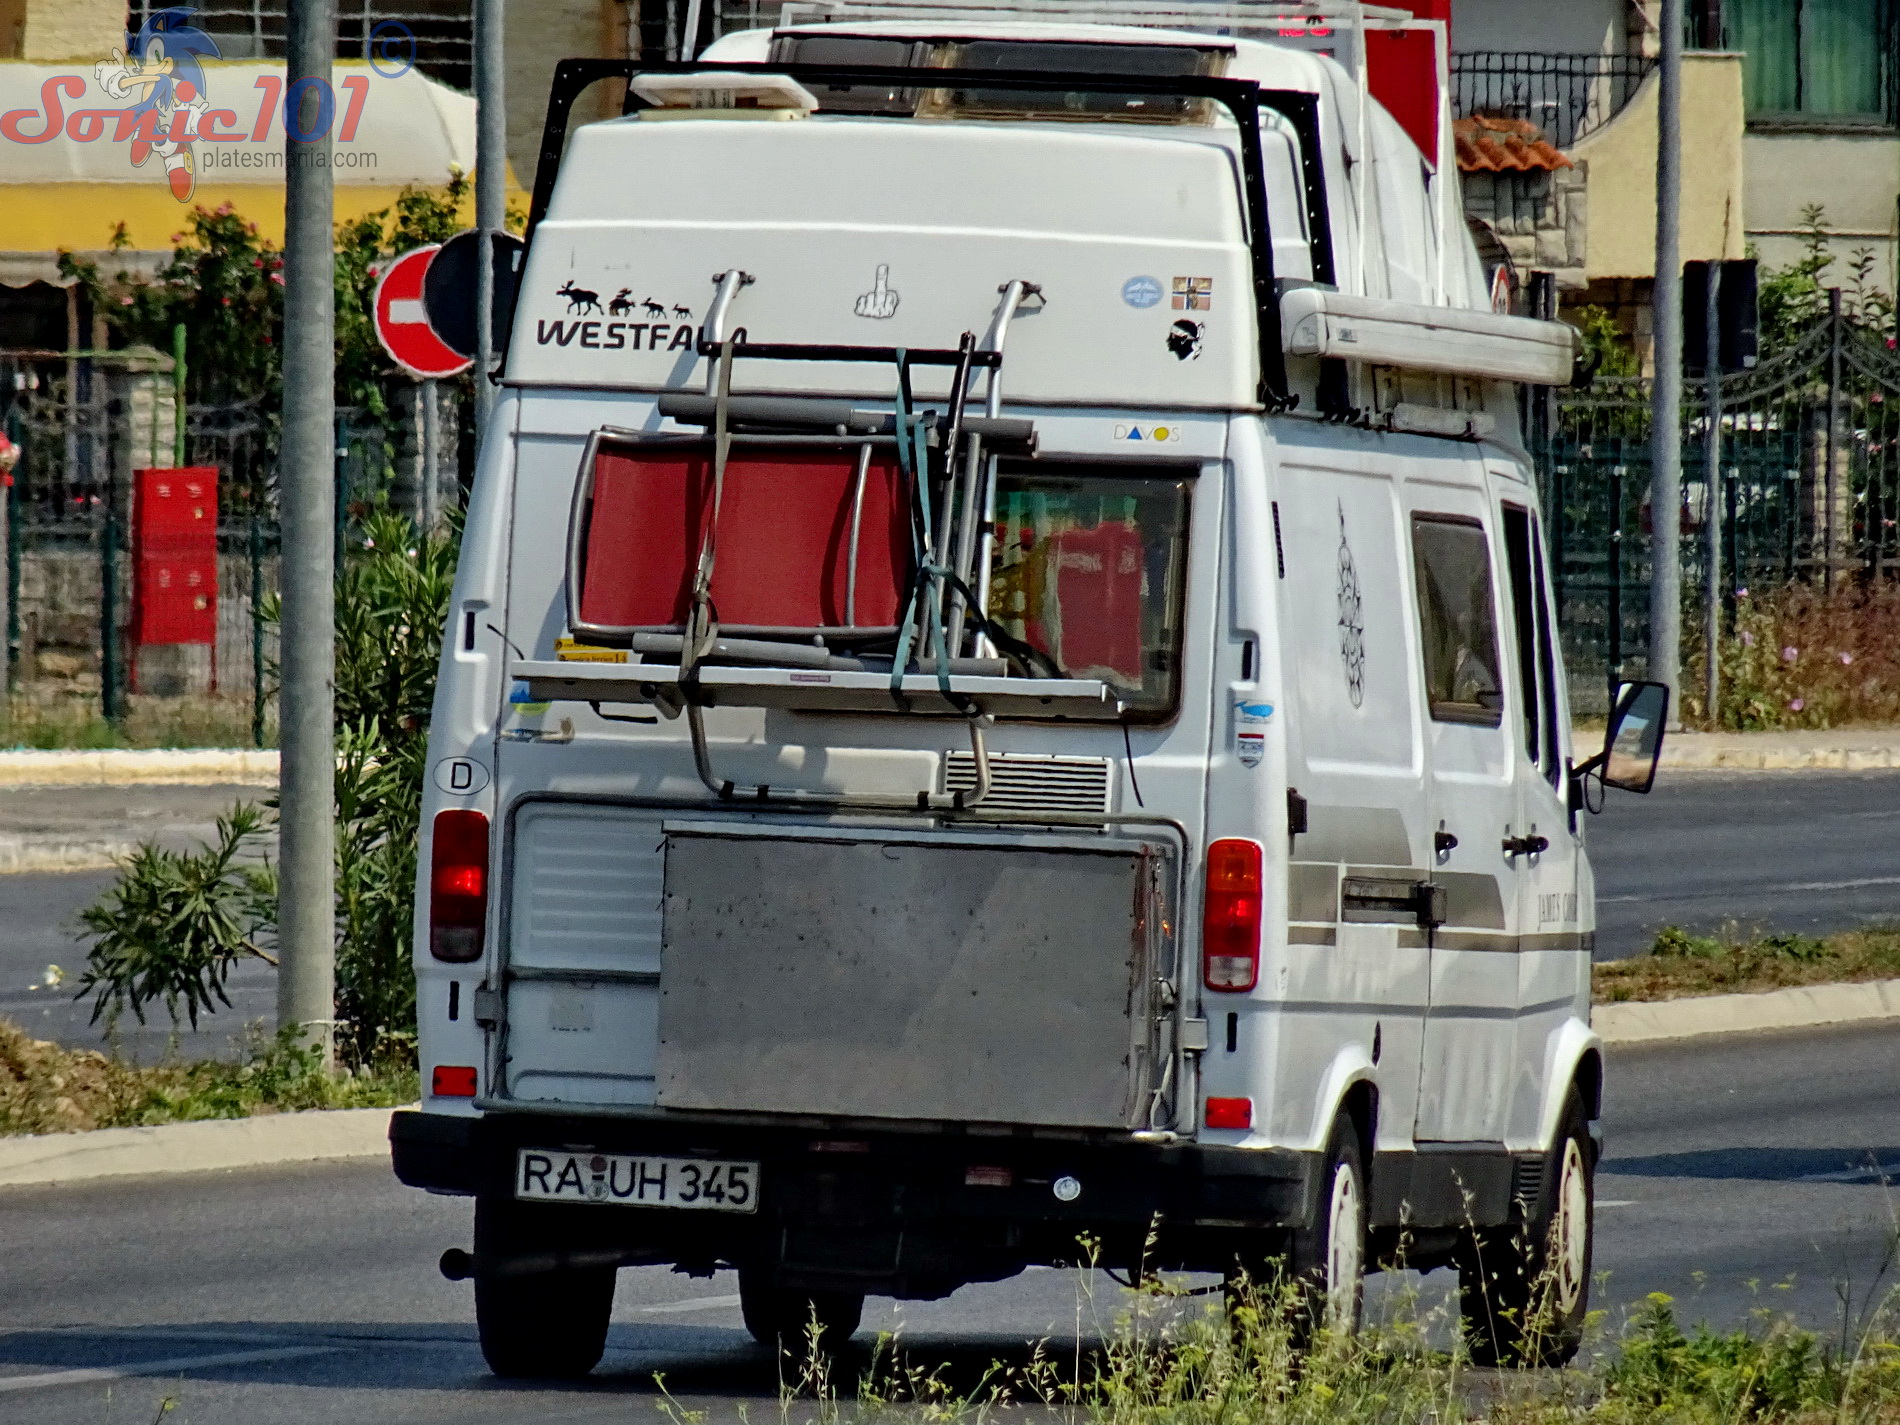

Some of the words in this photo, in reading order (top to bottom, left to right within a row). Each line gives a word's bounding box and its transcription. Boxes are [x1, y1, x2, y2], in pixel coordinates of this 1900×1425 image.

[537, 319, 748, 352] WESTFAA
[451, 762, 472, 789] D
[678, 1164, 749, 1205] 345
